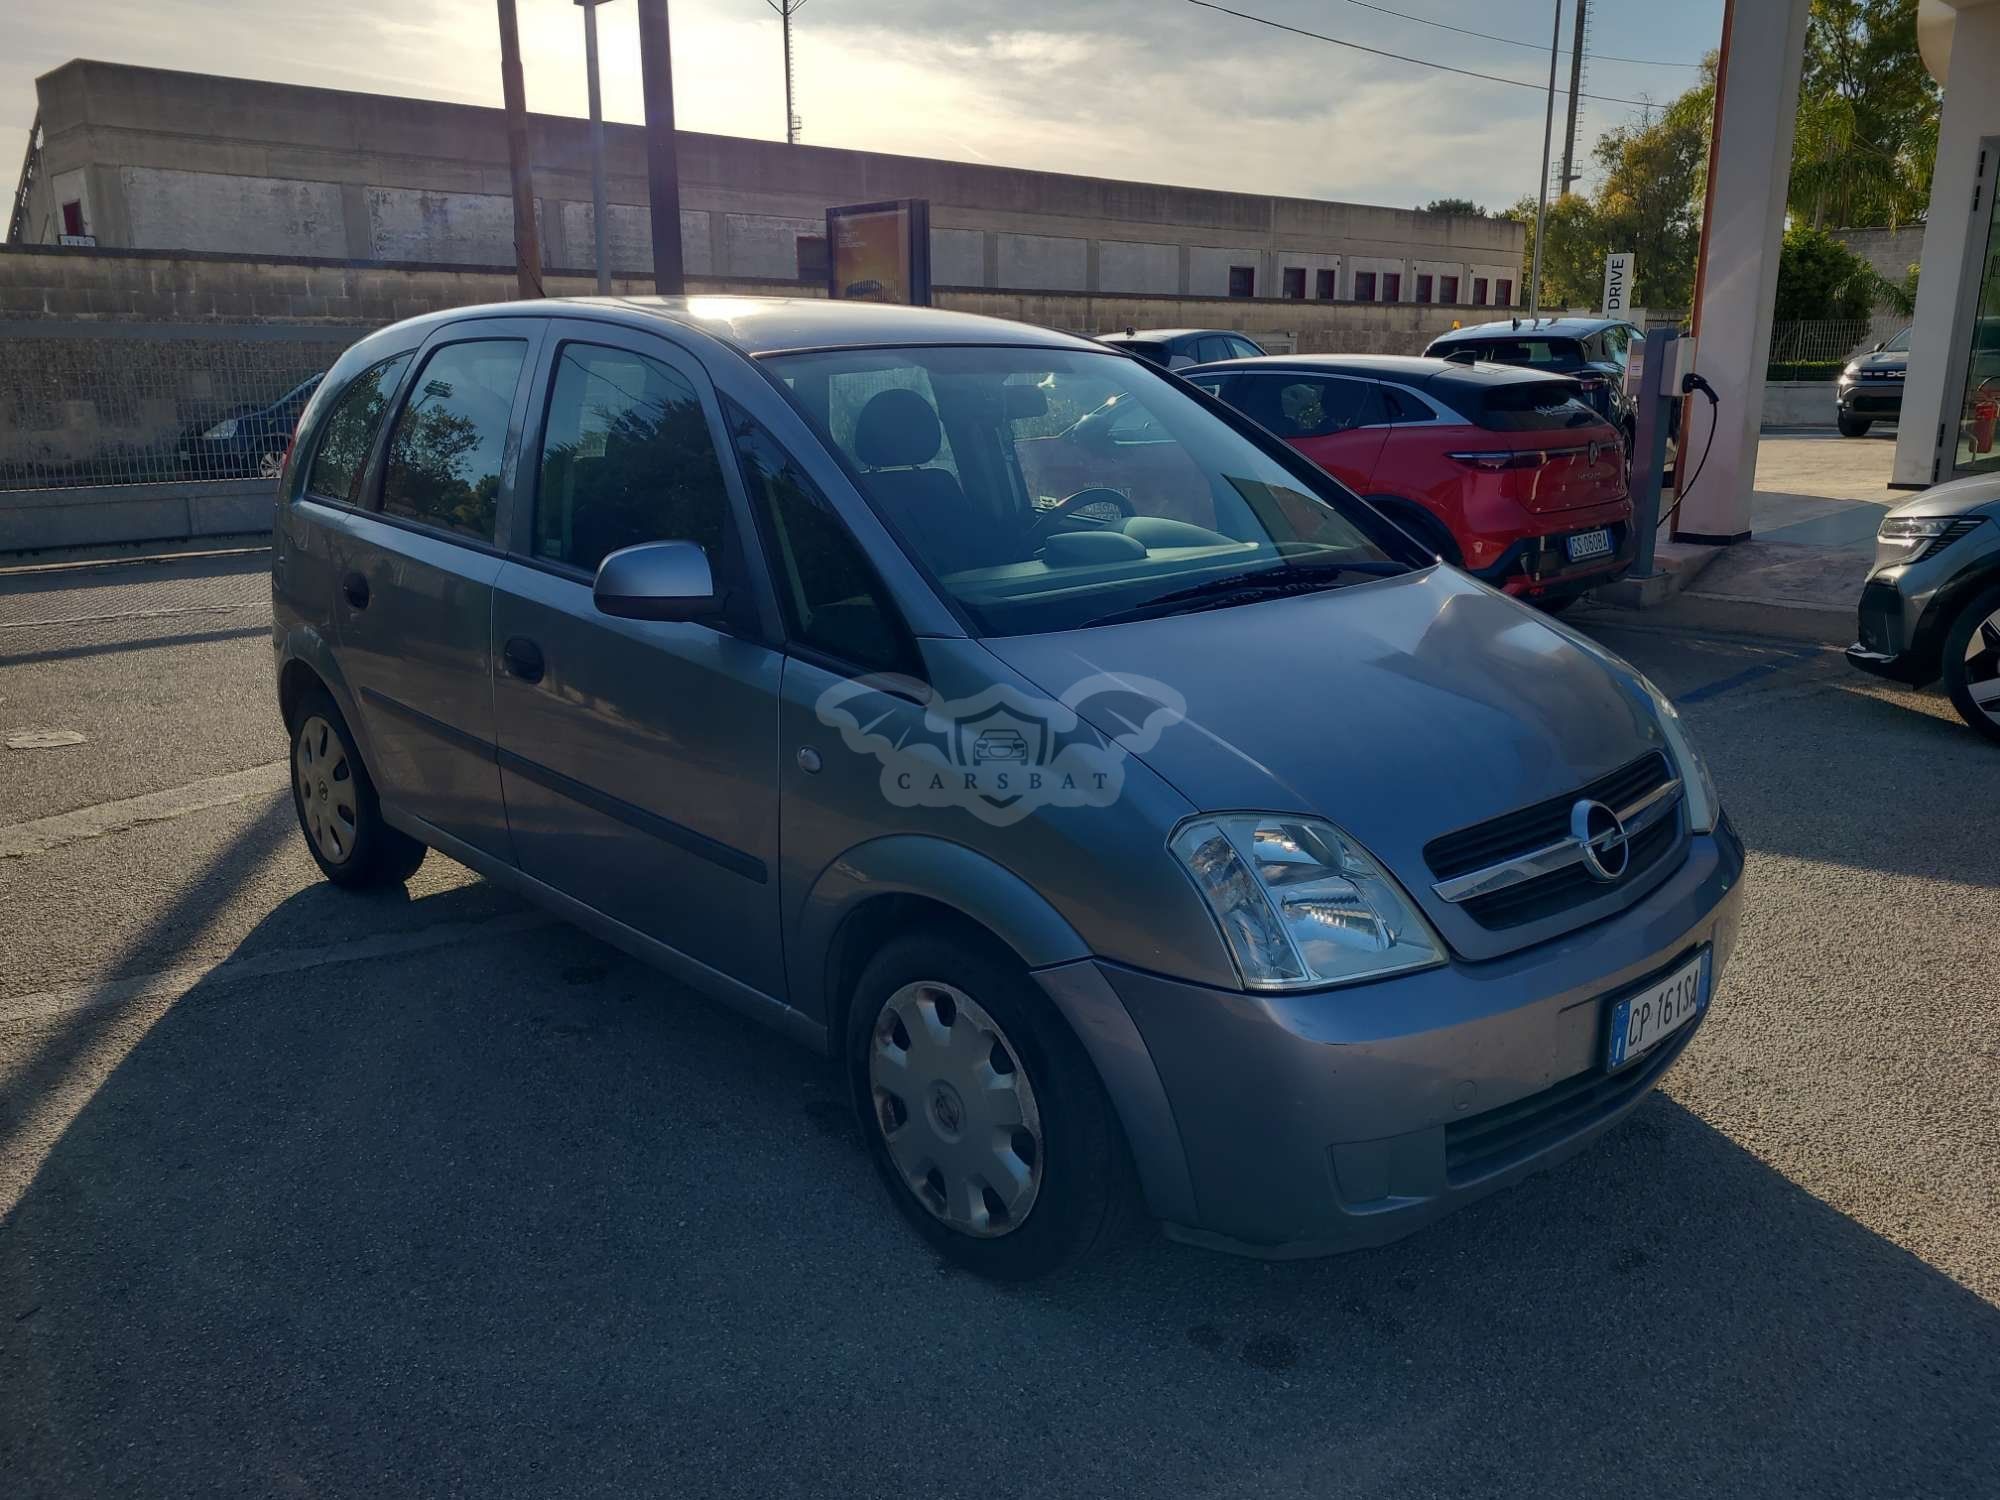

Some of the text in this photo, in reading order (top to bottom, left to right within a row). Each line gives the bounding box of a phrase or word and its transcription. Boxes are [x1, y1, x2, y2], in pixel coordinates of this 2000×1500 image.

[1608, 259, 1624, 310] DRIVE
[1628, 1002, 1651, 1047] CP
[1657, 969, 1698, 1030] 161SA
